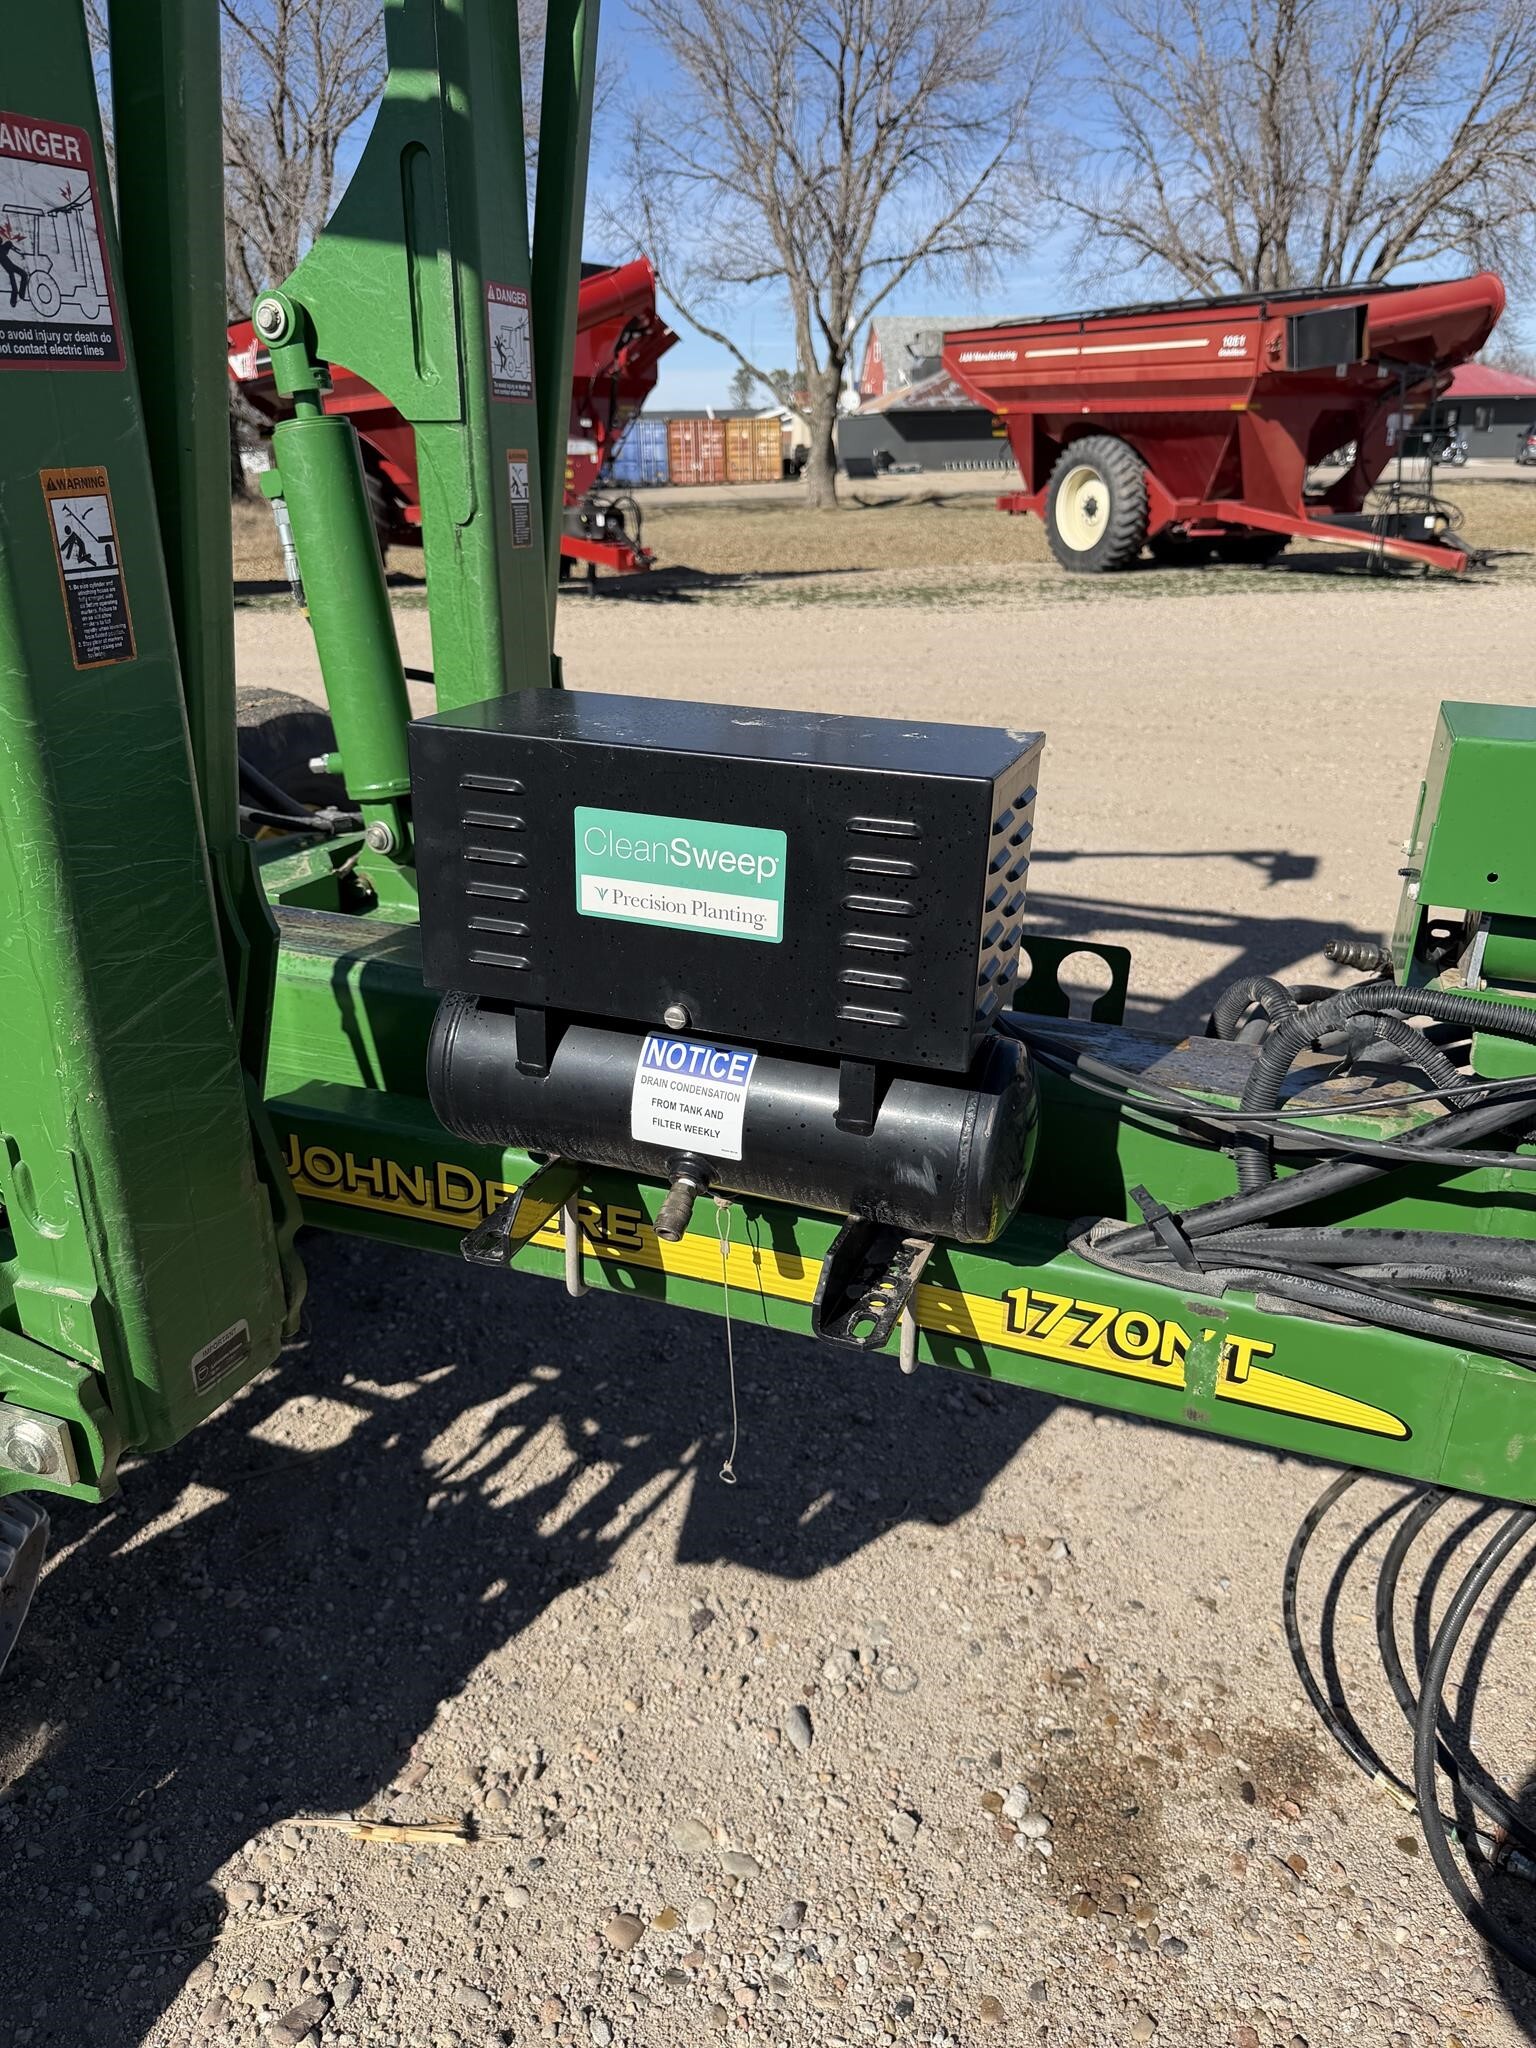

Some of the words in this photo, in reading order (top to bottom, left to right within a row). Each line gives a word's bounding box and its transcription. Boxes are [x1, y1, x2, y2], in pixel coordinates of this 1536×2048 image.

[0, 122, 82, 163] ANGER
[495, 287, 527, 306] DANGER
[7, 328, 34, 341] avoid
[35, 329, 61, 344] injury
[63, 332, 74, 342] or
[74, 331, 99, 343] death
[100, 332, 112, 343] do
[13, 343, 48, 355] contact
[49, 344, 82, 356] electric
[84, 345, 105, 356] lines
[57, 475, 106, 491] WARNING
[584, 826, 778, 884] CleanSweep
[612, 888, 687, 915] Precision
[691, 900, 765, 931] Planting
[646, 1039, 749, 1083] NOTICE
[640, 1074, 669, 1089] DRAIN
[670, 1080, 741, 1103] CONDENSATION
[651, 1097, 677, 1111] FROM
[679, 1102, 703, 1117] TANK
[704, 1109, 724, 1120] AND
[652, 1117, 682, 1132] FILTER
[683, 1124, 721, 1139] WEEKLY
[284, 1133, 426, 1206] JOHN
[433, 1161, 645, 1249] DERE
